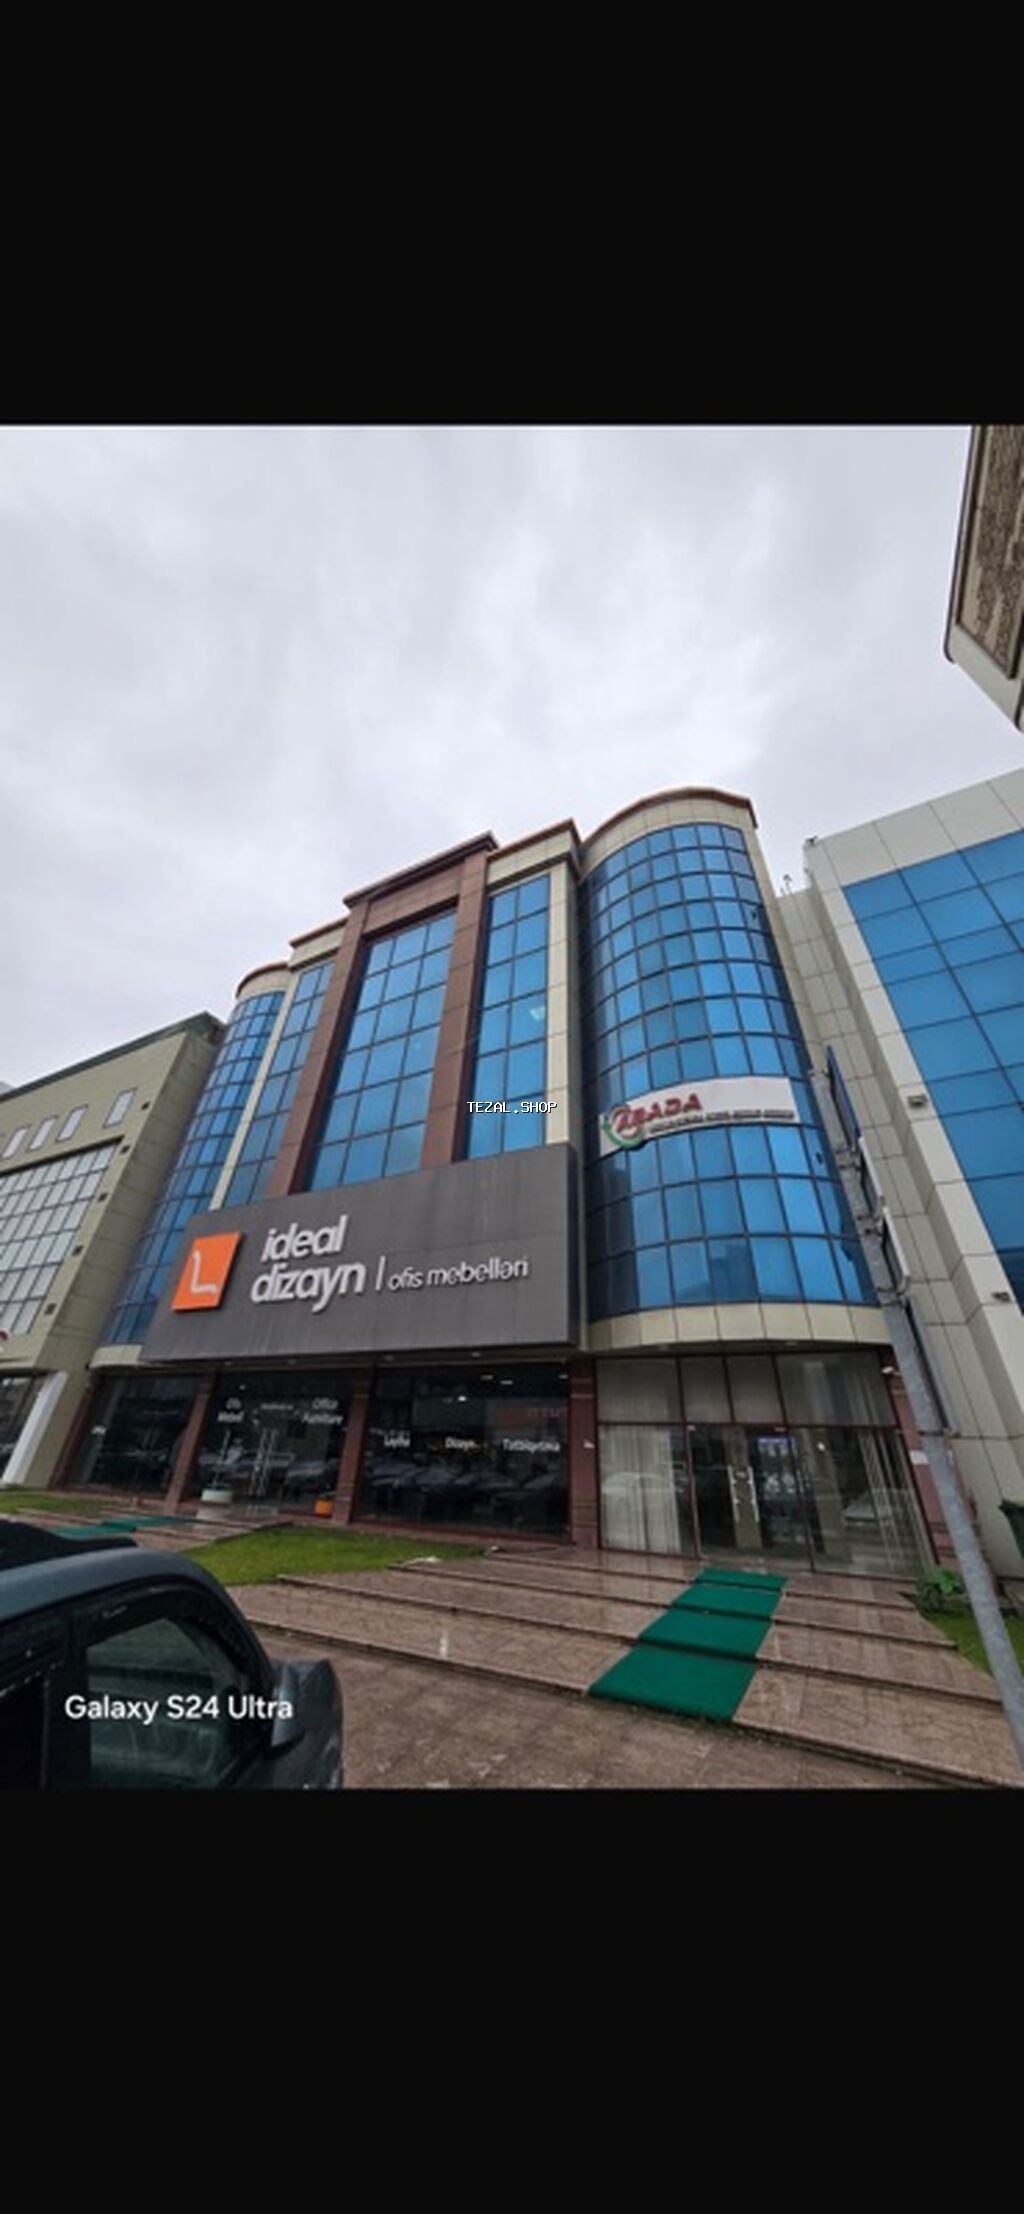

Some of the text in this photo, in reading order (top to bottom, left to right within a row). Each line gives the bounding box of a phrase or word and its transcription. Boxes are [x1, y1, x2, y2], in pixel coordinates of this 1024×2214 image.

[260, 1213, 349, 1262] ideal
[251, 1261, 366, 1312] dizayn
[387, 1255, 529, 1290] ofis mebelləri
